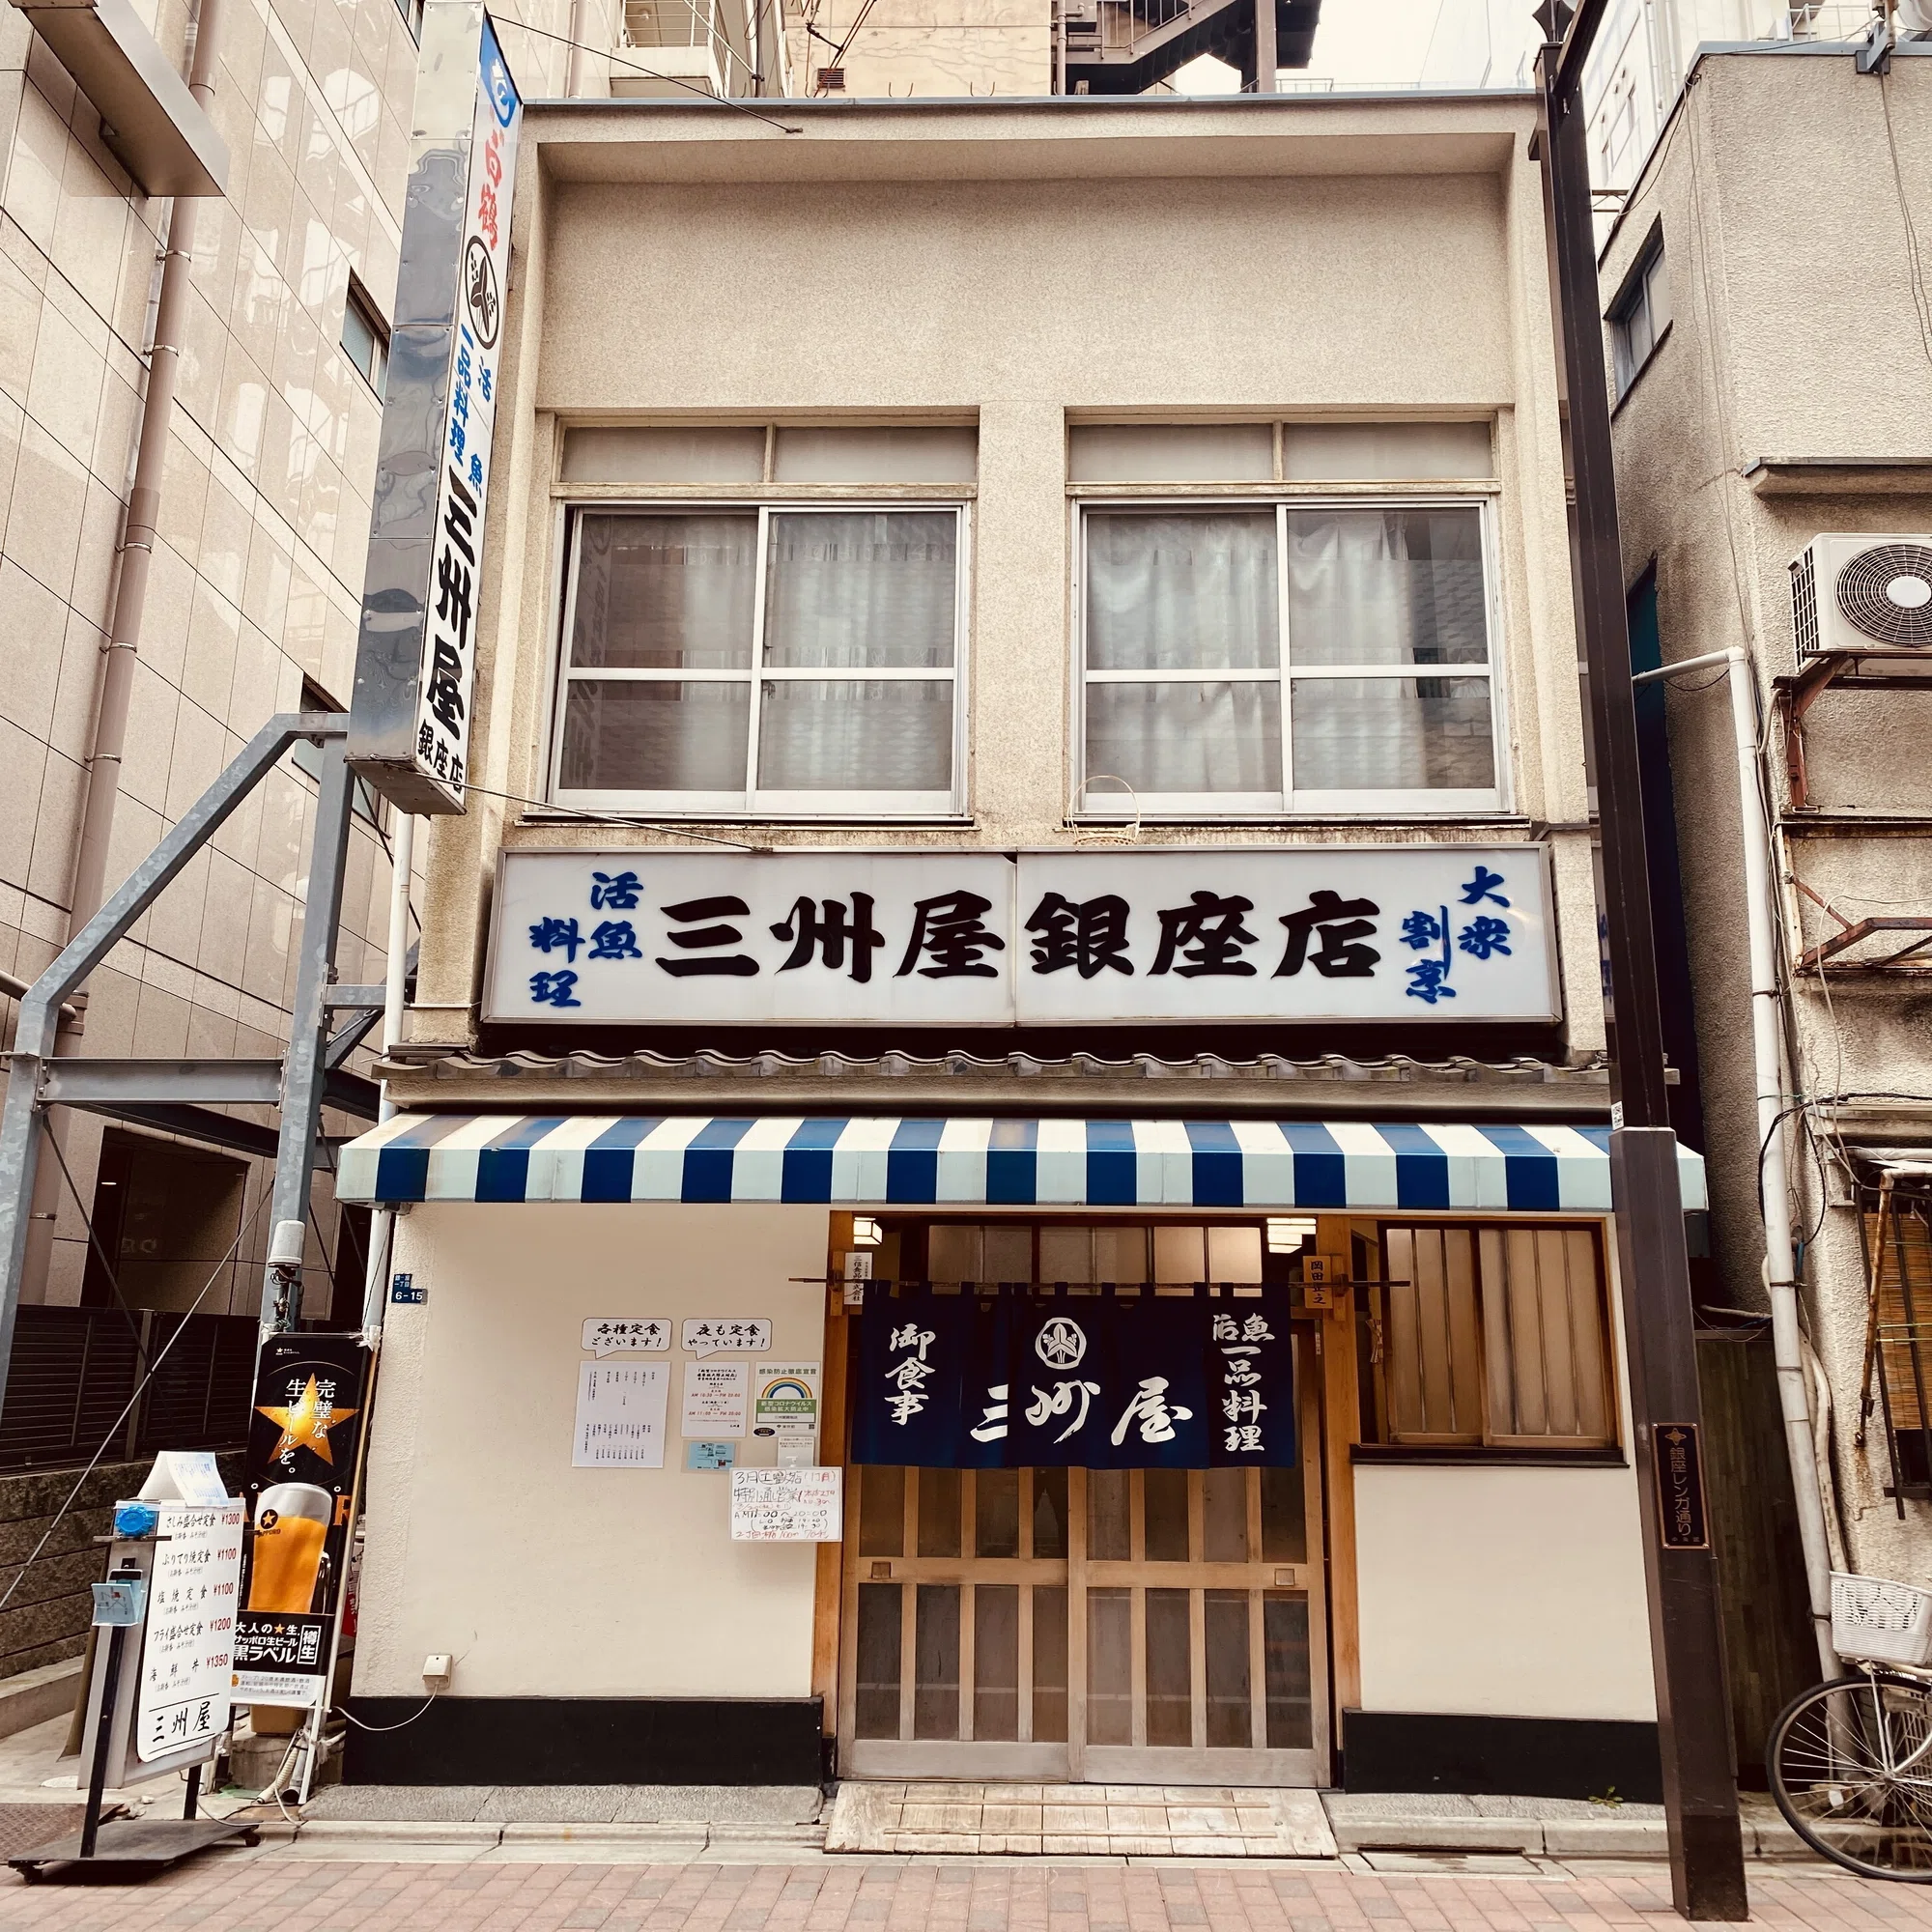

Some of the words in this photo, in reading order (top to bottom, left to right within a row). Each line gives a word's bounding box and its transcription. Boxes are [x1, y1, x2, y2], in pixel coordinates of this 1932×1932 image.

[478, 139, 502, 251] 白鶴
[448, 324, 473, 468] 一品料理
[426, 465, 477, 741] 三州屋
[417, 720, 464, 793] 銀座店
[588, 871, 644, 960] 活魚
[655, 890, 1381, 983] 三州屋銀座店
[1457, 866, 1512, 960] 大衆
[529, 917, 585, 1008] 料理
[1399, 905, 1457, 1004] 割烹
[395, 1292, 423, 1300] 6-15
[853, 1255, 863, 1302] 三信食品式会社
[591, 1337, 662, 1348] ございます!
[597, 1323, 661, 1336] 各種定食
[696, 1324, 760, 1336] 夜も定食
[884, 1323, 936, 1426] 御食事
[310, 1378, 336, 1438] 完璧な
[970, 1377, 1193, 1446] 三州屋
[1669, 1447, 1692, 1536] 銀座レンガ通り
[221, 1513, 240, 1525] ¥1300
[217, 1548, 237, 1561] ¥1100
[213, 1582, 234, 1596] ¥1100
[210, 1617, 231, 1632] ¥1200
[300, 1630, 318, 1660] 樽生
[207, 1653, 228, 1668] ¥1350
[234, 1644, 297, 1662] 黒ラベル
[153, 1701, 211, 1742] 三州屋
